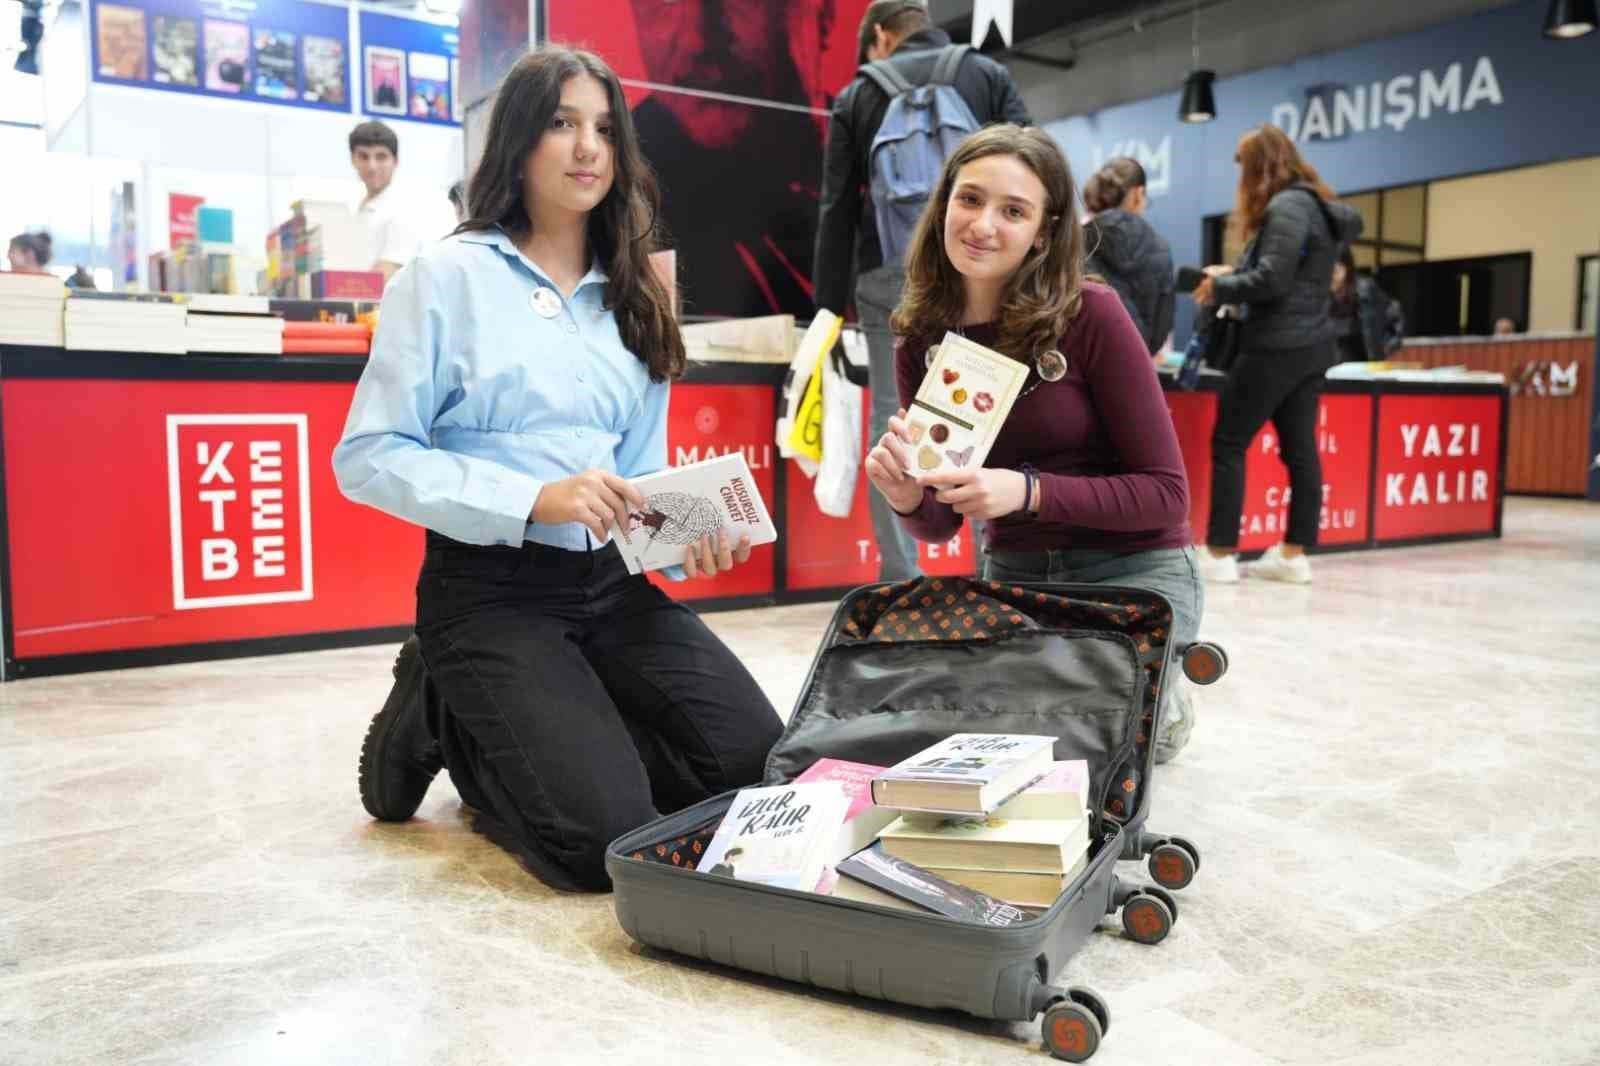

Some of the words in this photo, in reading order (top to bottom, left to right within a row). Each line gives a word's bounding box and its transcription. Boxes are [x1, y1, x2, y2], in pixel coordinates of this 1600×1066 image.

[1271, 56, 1503, 142] DANIŞMA
[1400, 424, 1480, 458] YAZI
[730, 476, 761, 526] KUSURSUZ
[1384, 469, 1489, 507] KALIR
[739, 804, 812, 837] KALIR
